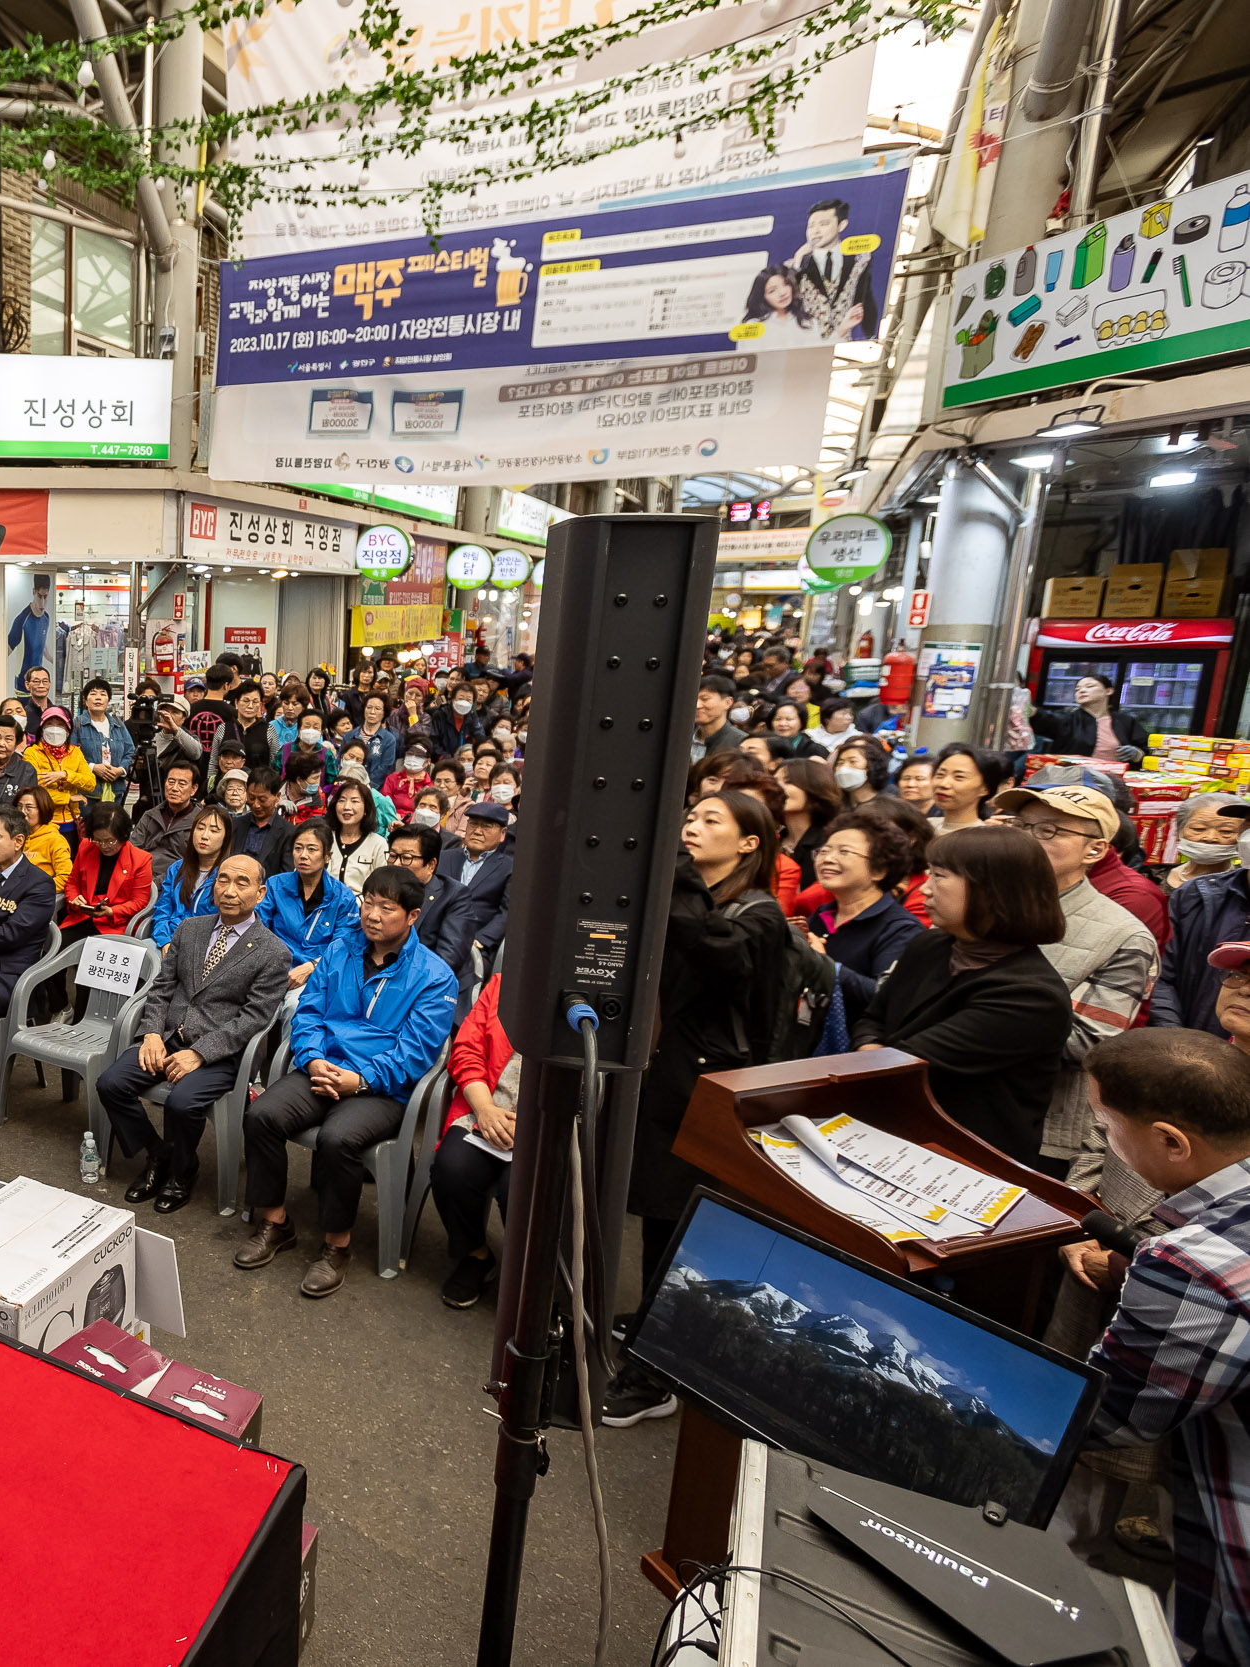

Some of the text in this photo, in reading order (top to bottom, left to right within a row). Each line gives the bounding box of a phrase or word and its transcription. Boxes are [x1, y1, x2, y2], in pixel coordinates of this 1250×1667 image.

[333, 257, 405, 321] 맥주
[408, 247, 489, 288] 페스티벌
[228, 291, 330, 325] 고객과 함께 하는
[230, 331, 290, 354] 2023.10.17
[292, 329, 314, 349] (화)
[316, 324, 389, 346] 16:00~20:00
[399, 314, 500, 340] 자양전통시장
[502, 308, 522, 332] 내
[23, 397, 134, 429] 진성상회
[90, 444, 153, 456] T.447-7850
[192, 509, 342, 553] BYC 진성상회 직영점
[368, 534, 396, 547] BYC
[815, 527, 879, 545] 우리마트
[362, 549, 402, 565] 직영점
[831, 545, 862, 562] 생선
[1085, 621, 1179, 642] Coca-Cola
[88, 964, 131, 984] 광진구청장
[93, 1225, 133, 1265] CUCKOO
